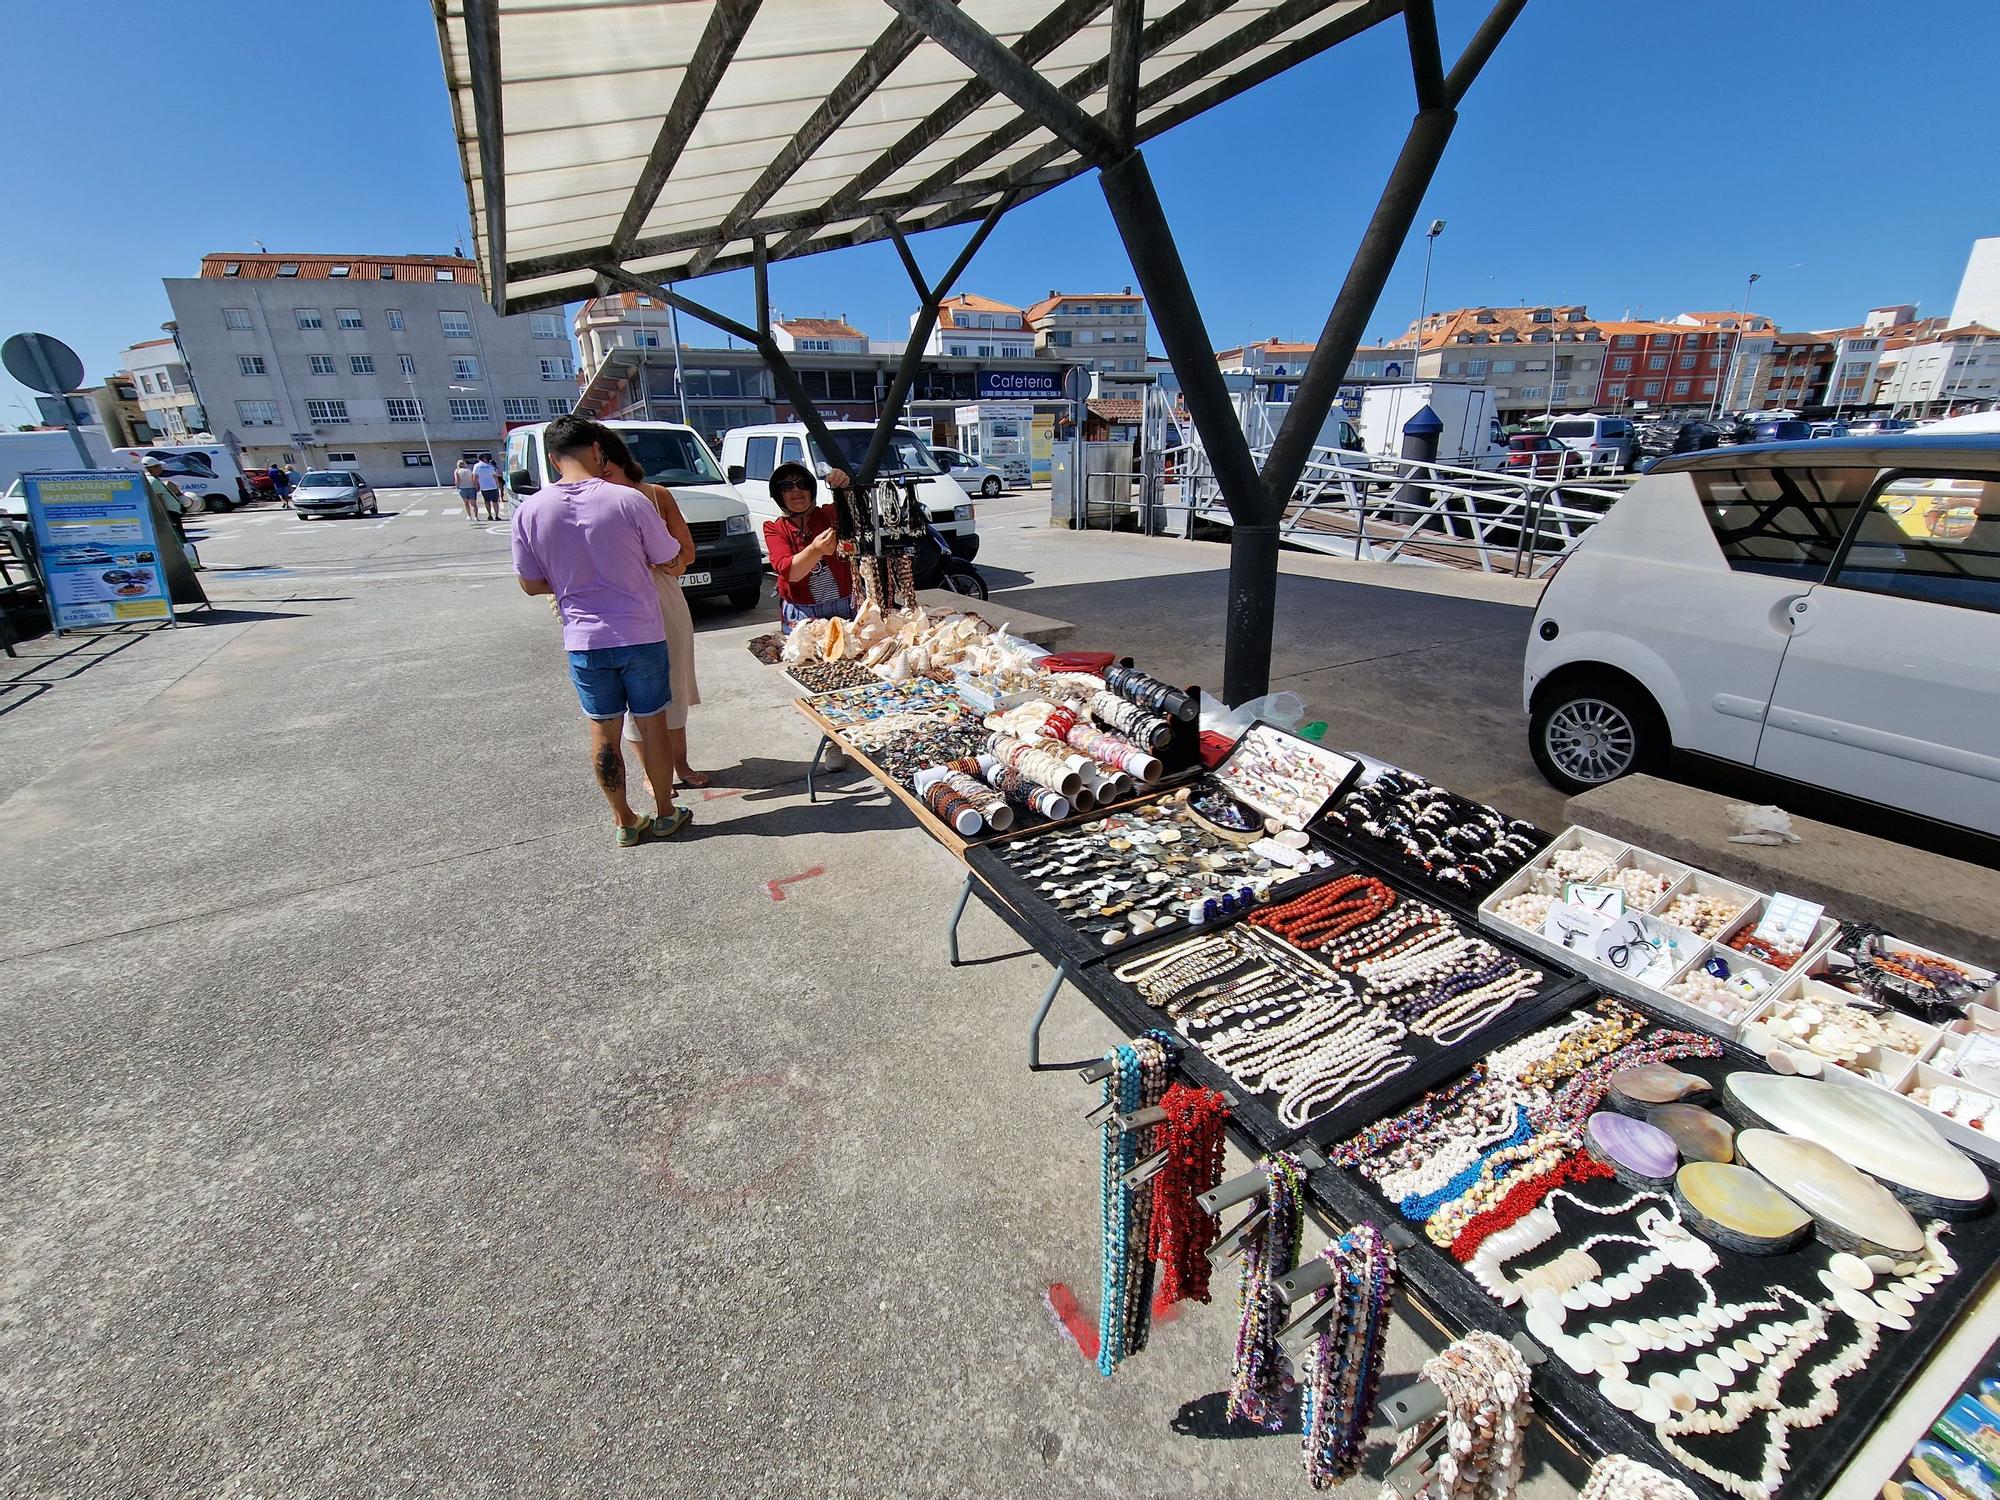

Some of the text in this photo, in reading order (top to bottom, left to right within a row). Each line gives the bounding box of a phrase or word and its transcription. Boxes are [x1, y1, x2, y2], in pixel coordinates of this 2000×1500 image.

[990, 374, 1052, 388] Cafeteria
[41, 482, 127, 491] RESTAURANTE
[44, 493, 107, 502] MARINERO
[690, 574, 709, 584] DLG
